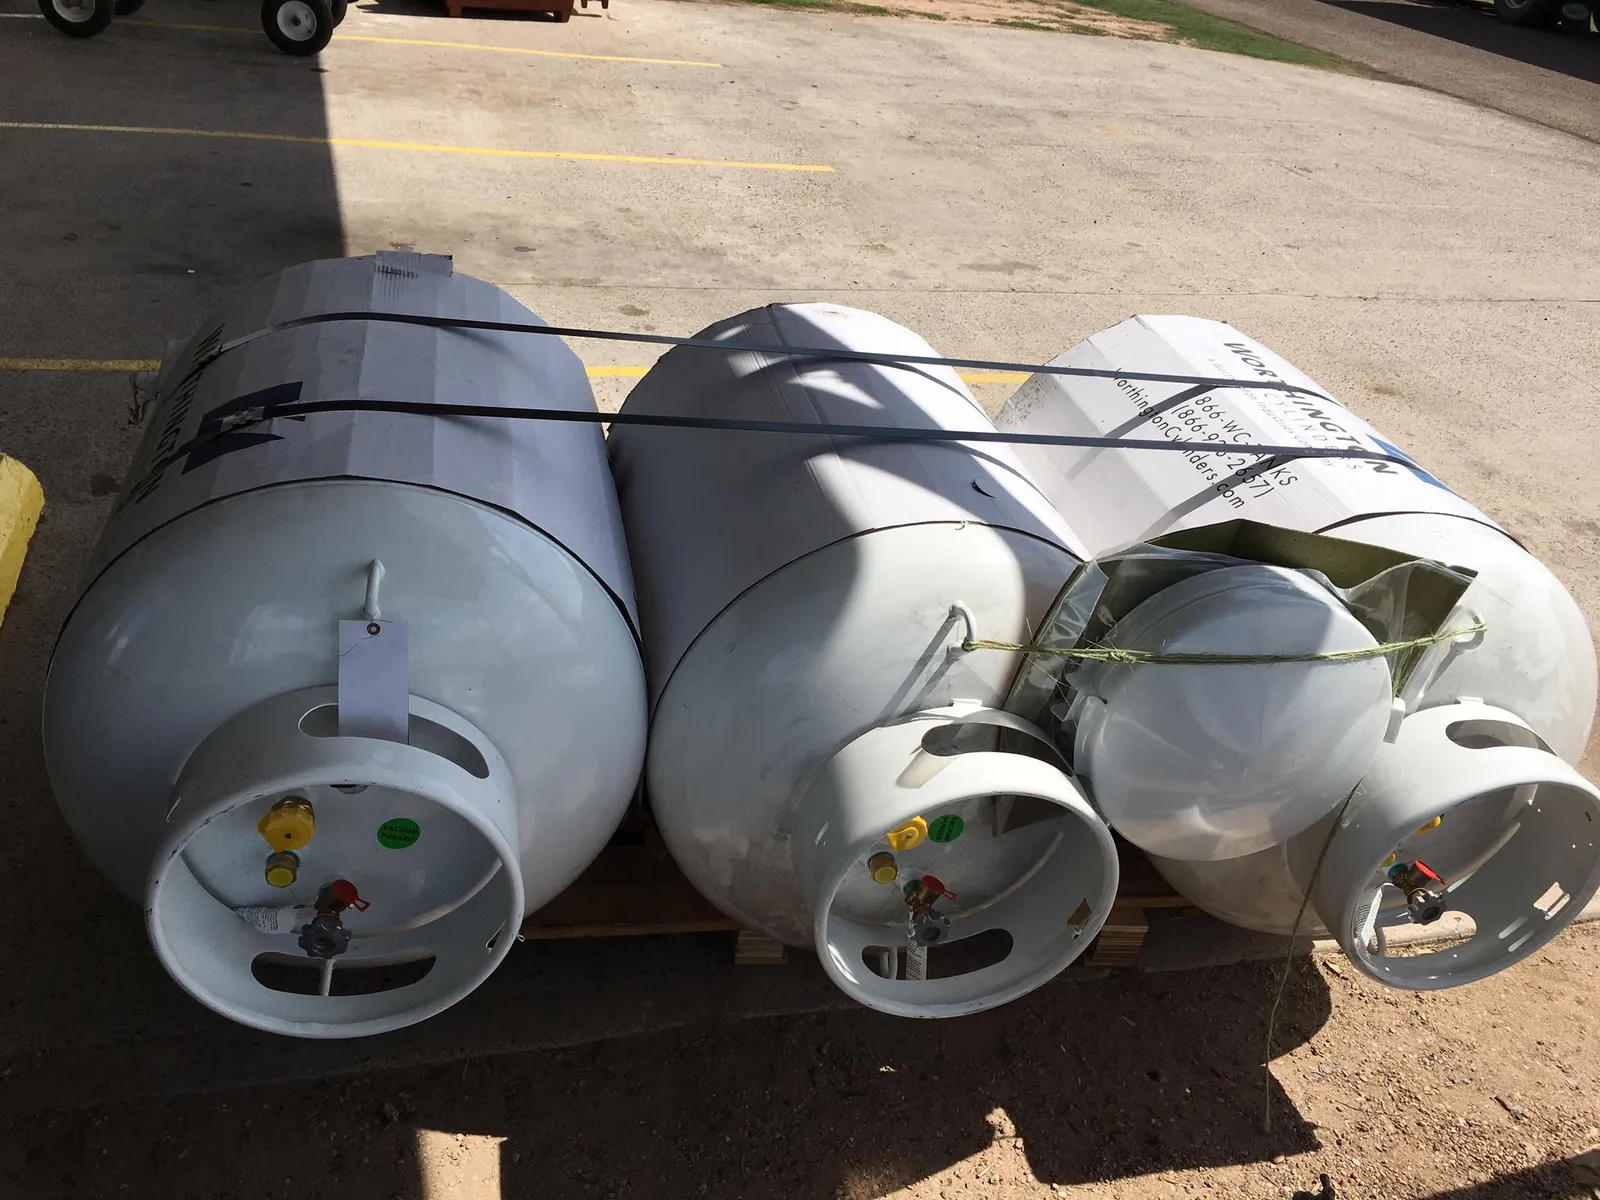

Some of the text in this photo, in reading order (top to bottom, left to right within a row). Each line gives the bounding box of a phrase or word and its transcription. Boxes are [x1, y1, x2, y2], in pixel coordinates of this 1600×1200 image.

[135, 323, 226, 505] WTHINGTN
[1113, 367, 1245, 509] orthingtonCynders.com
[1195, 396, 1298, 486] 866-WC-ANKS
[1223, 342, 1399, 475] WORHINGTN
[1264, 392, 1363, 469] CYLINDS
